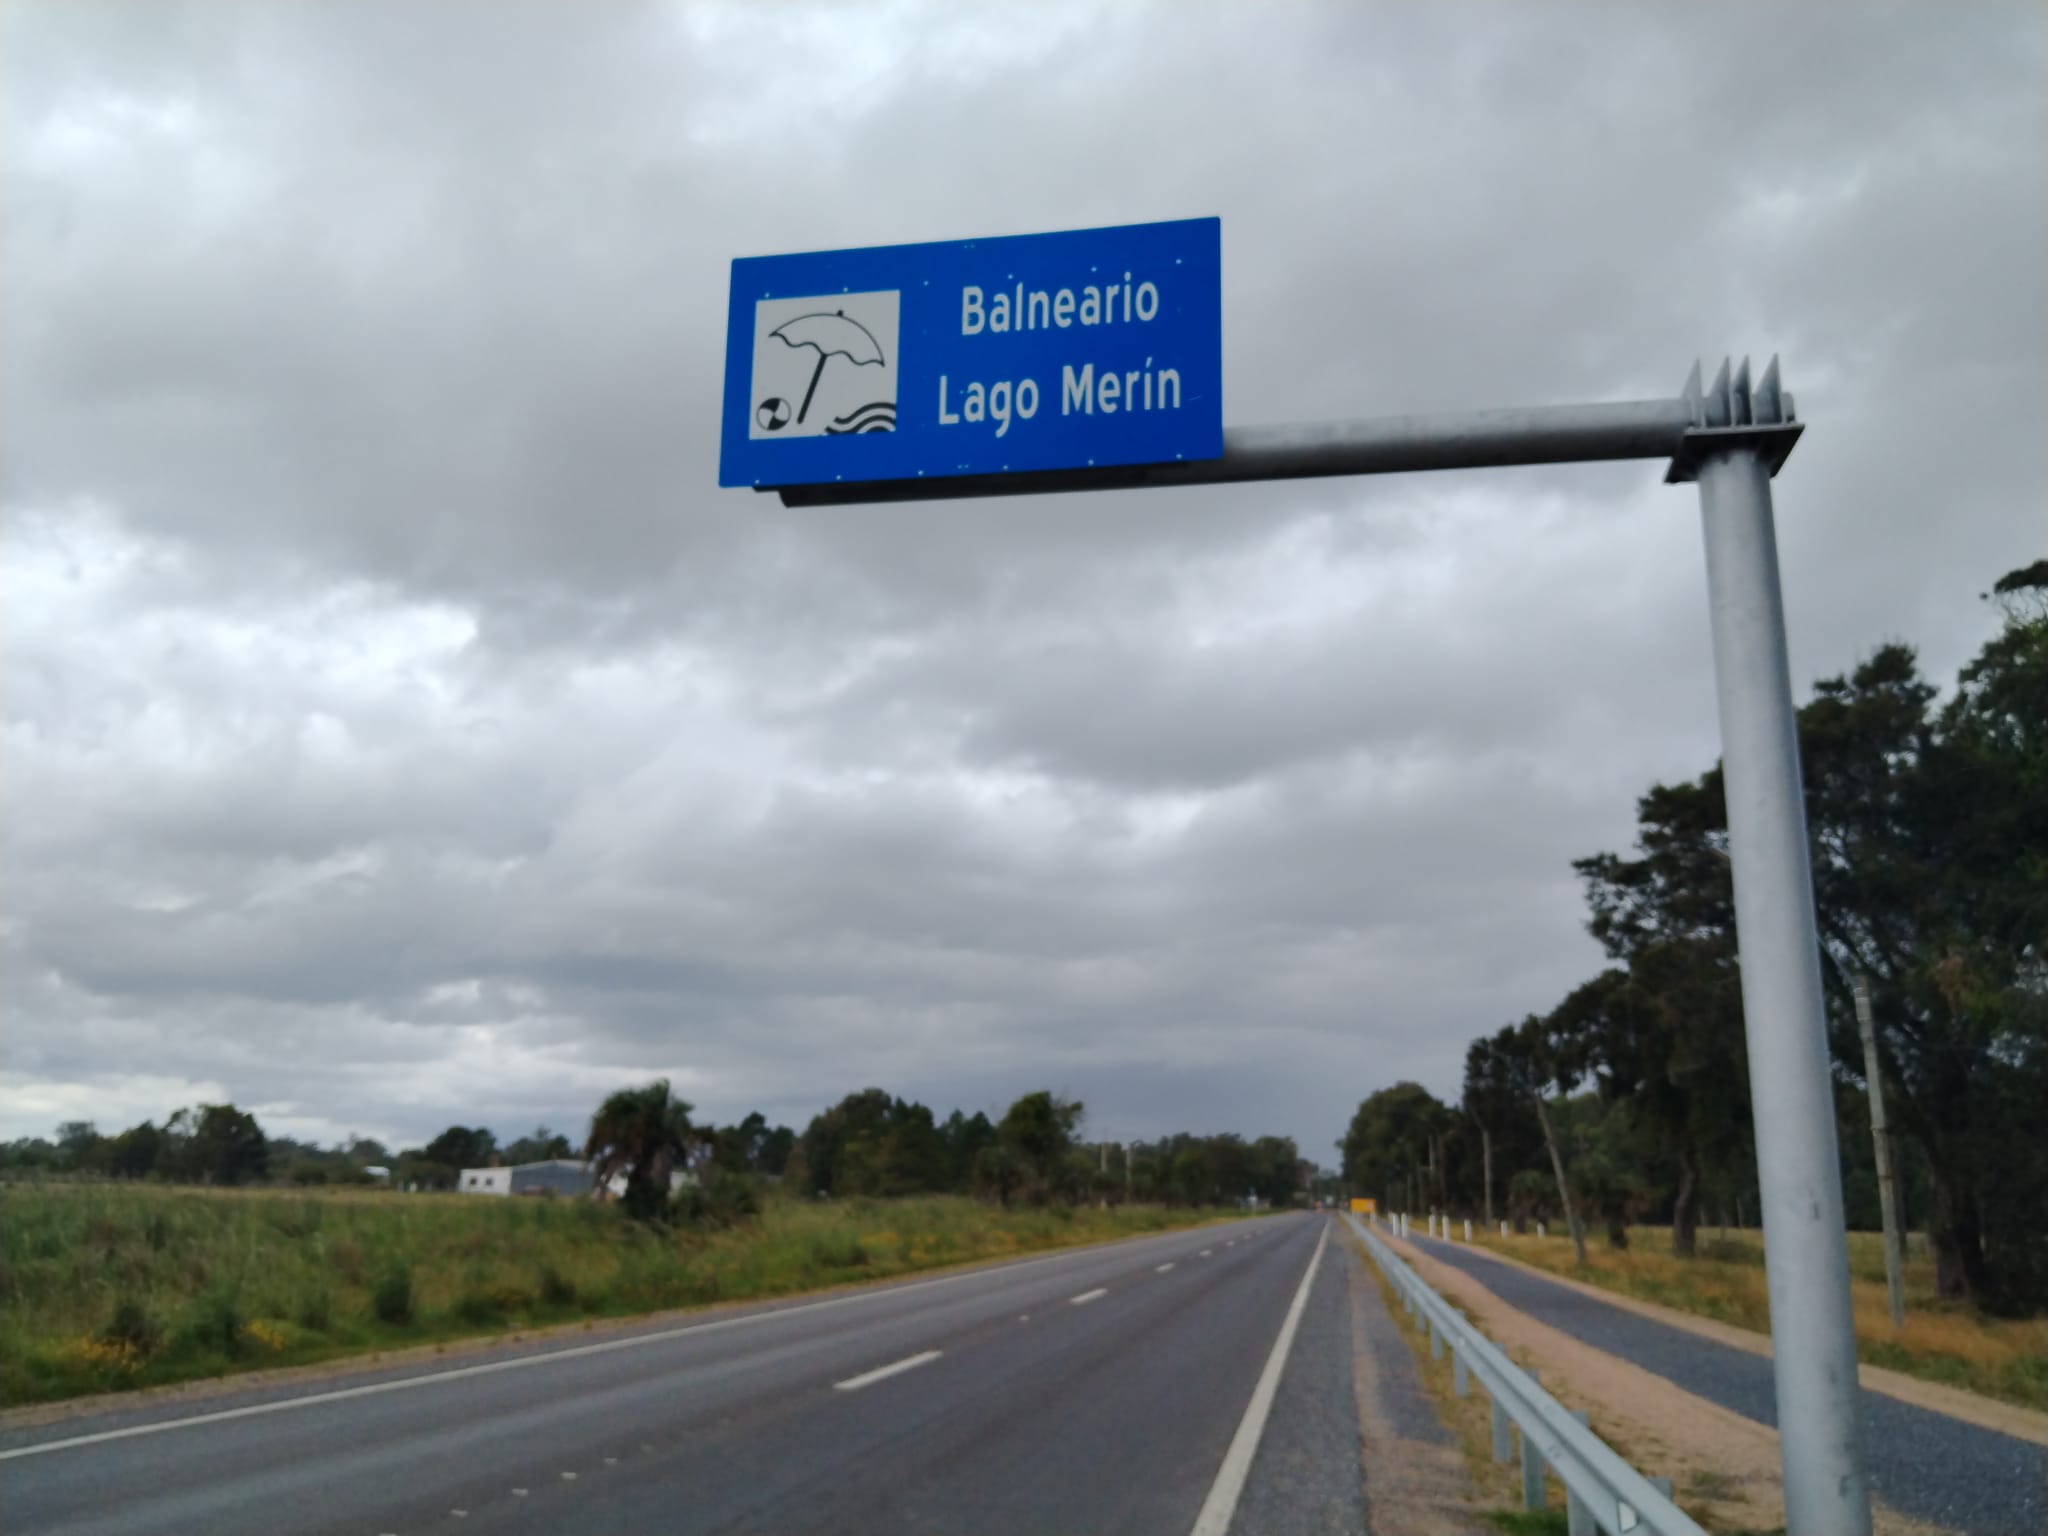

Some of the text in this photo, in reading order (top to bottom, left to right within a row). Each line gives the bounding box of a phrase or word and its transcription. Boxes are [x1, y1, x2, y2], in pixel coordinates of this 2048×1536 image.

[961, 271, 1159, 336] Balneario
[938, 357, 1181, 438] Lago Merín
